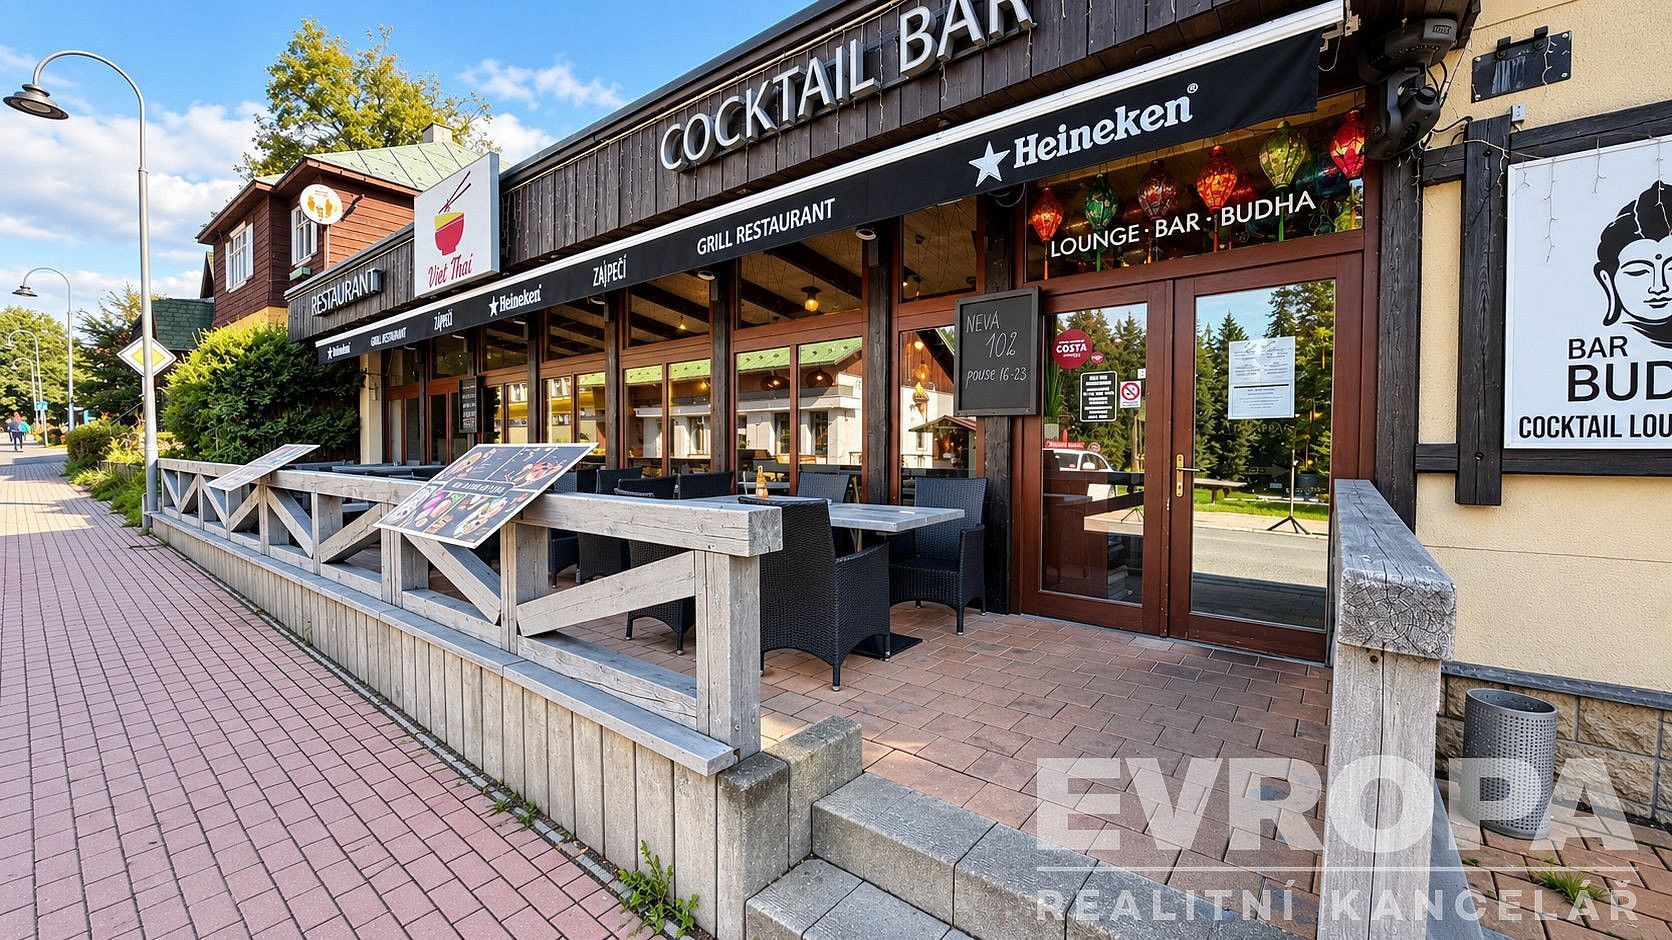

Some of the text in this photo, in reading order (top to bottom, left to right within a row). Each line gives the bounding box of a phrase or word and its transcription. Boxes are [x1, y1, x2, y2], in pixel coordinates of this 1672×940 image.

[660, 39, 879, 171] COCKTAIL
[697, 198, 835, 255] GRILL RESTAURANT
[1050, 190, 1316, 258] LOUNGE BAR BUDHA
[428, 253, 474, 288] Viet Thai
[311, 267, 381, 316] RESTAURANT
[985, 331, 1018, 358] 10%
[1056, 343, 1087, 353] COSTA
[1568, 336, 1628, 359] BAR
[1000, 367, 1027, 381] 16-23
[1519, 414, 1672, 438] COCKTAIL LOU
